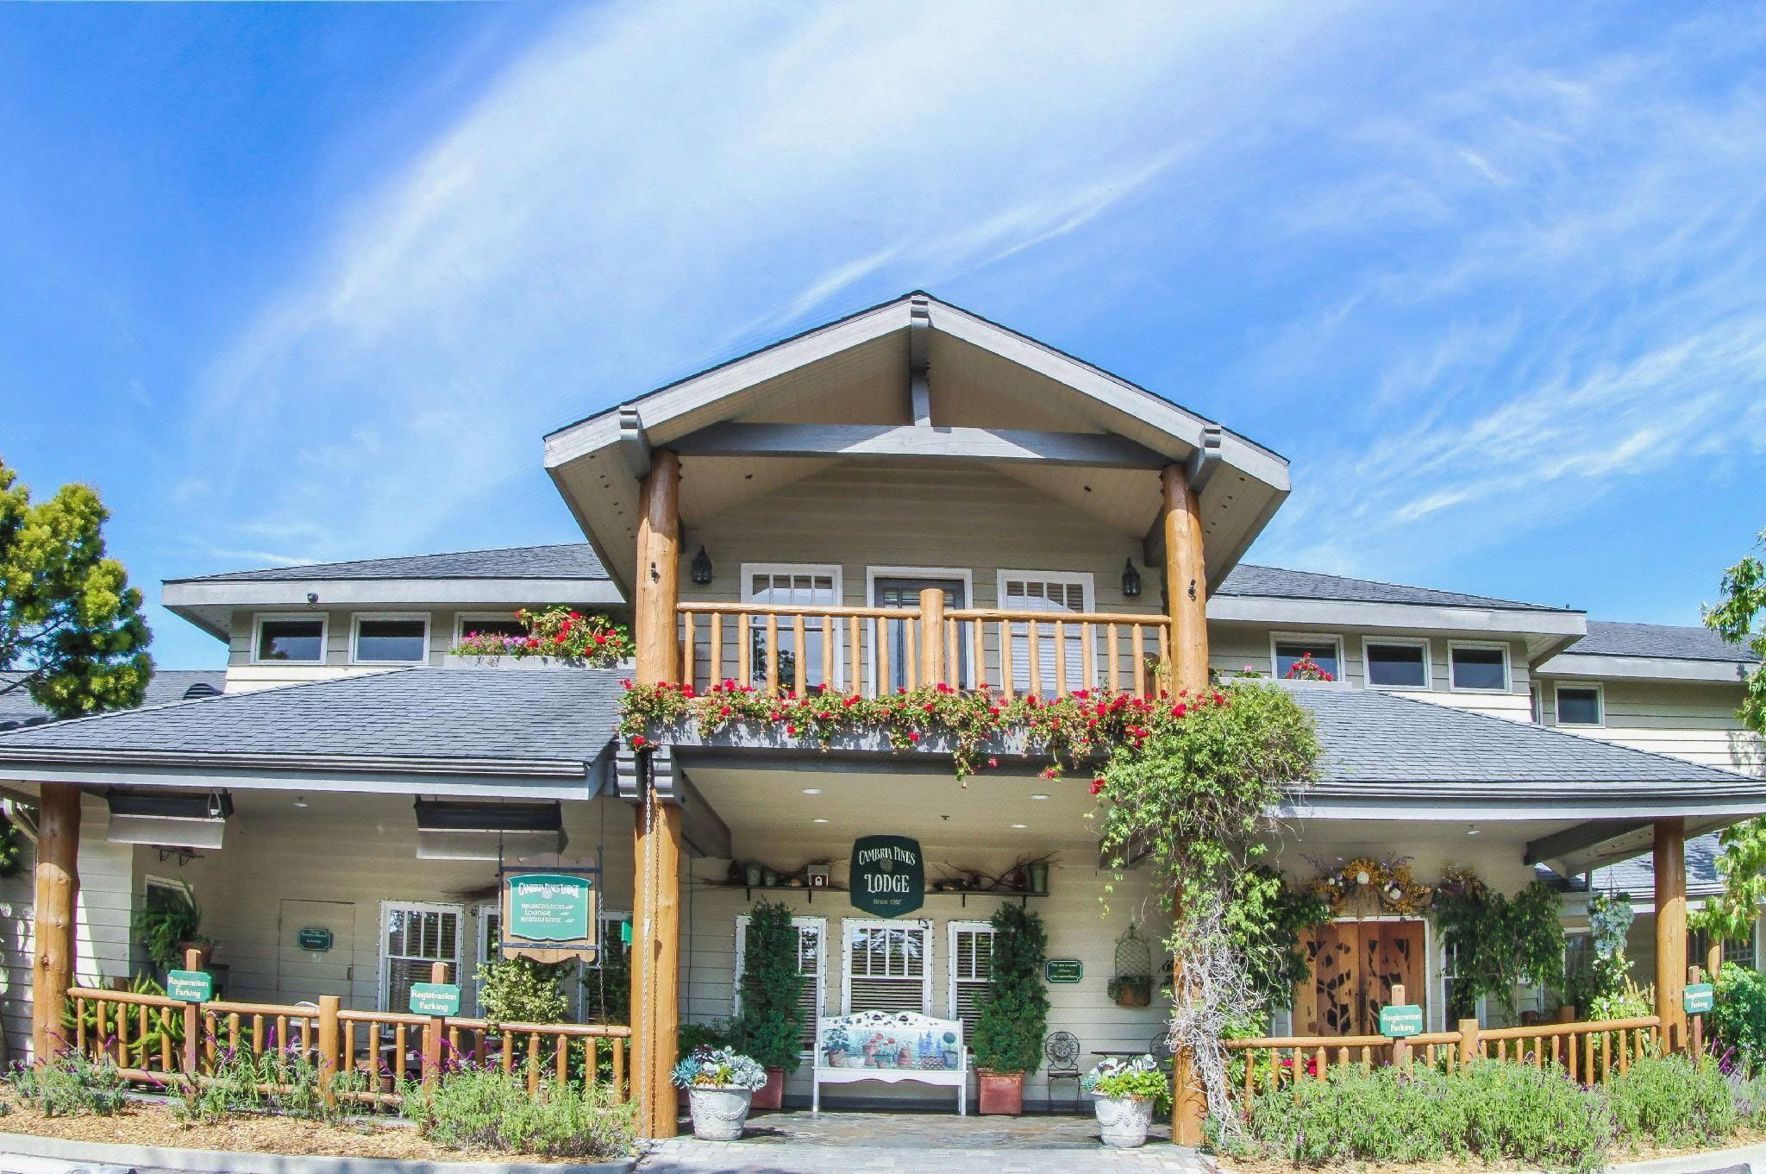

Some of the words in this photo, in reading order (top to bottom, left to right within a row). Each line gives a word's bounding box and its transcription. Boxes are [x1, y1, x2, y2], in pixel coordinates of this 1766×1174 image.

[859, 848, 892, 865] CAMBRIA
[894, 846, 915, 866] PINES
[864, 873, 910, 893] LODGE
[168, 976, 209, 988] Registration
[175, 988, 201, 1000] Parking
[411, 989, 457, 1001] Registration
[419, 1001, 449, 1013] Parking
